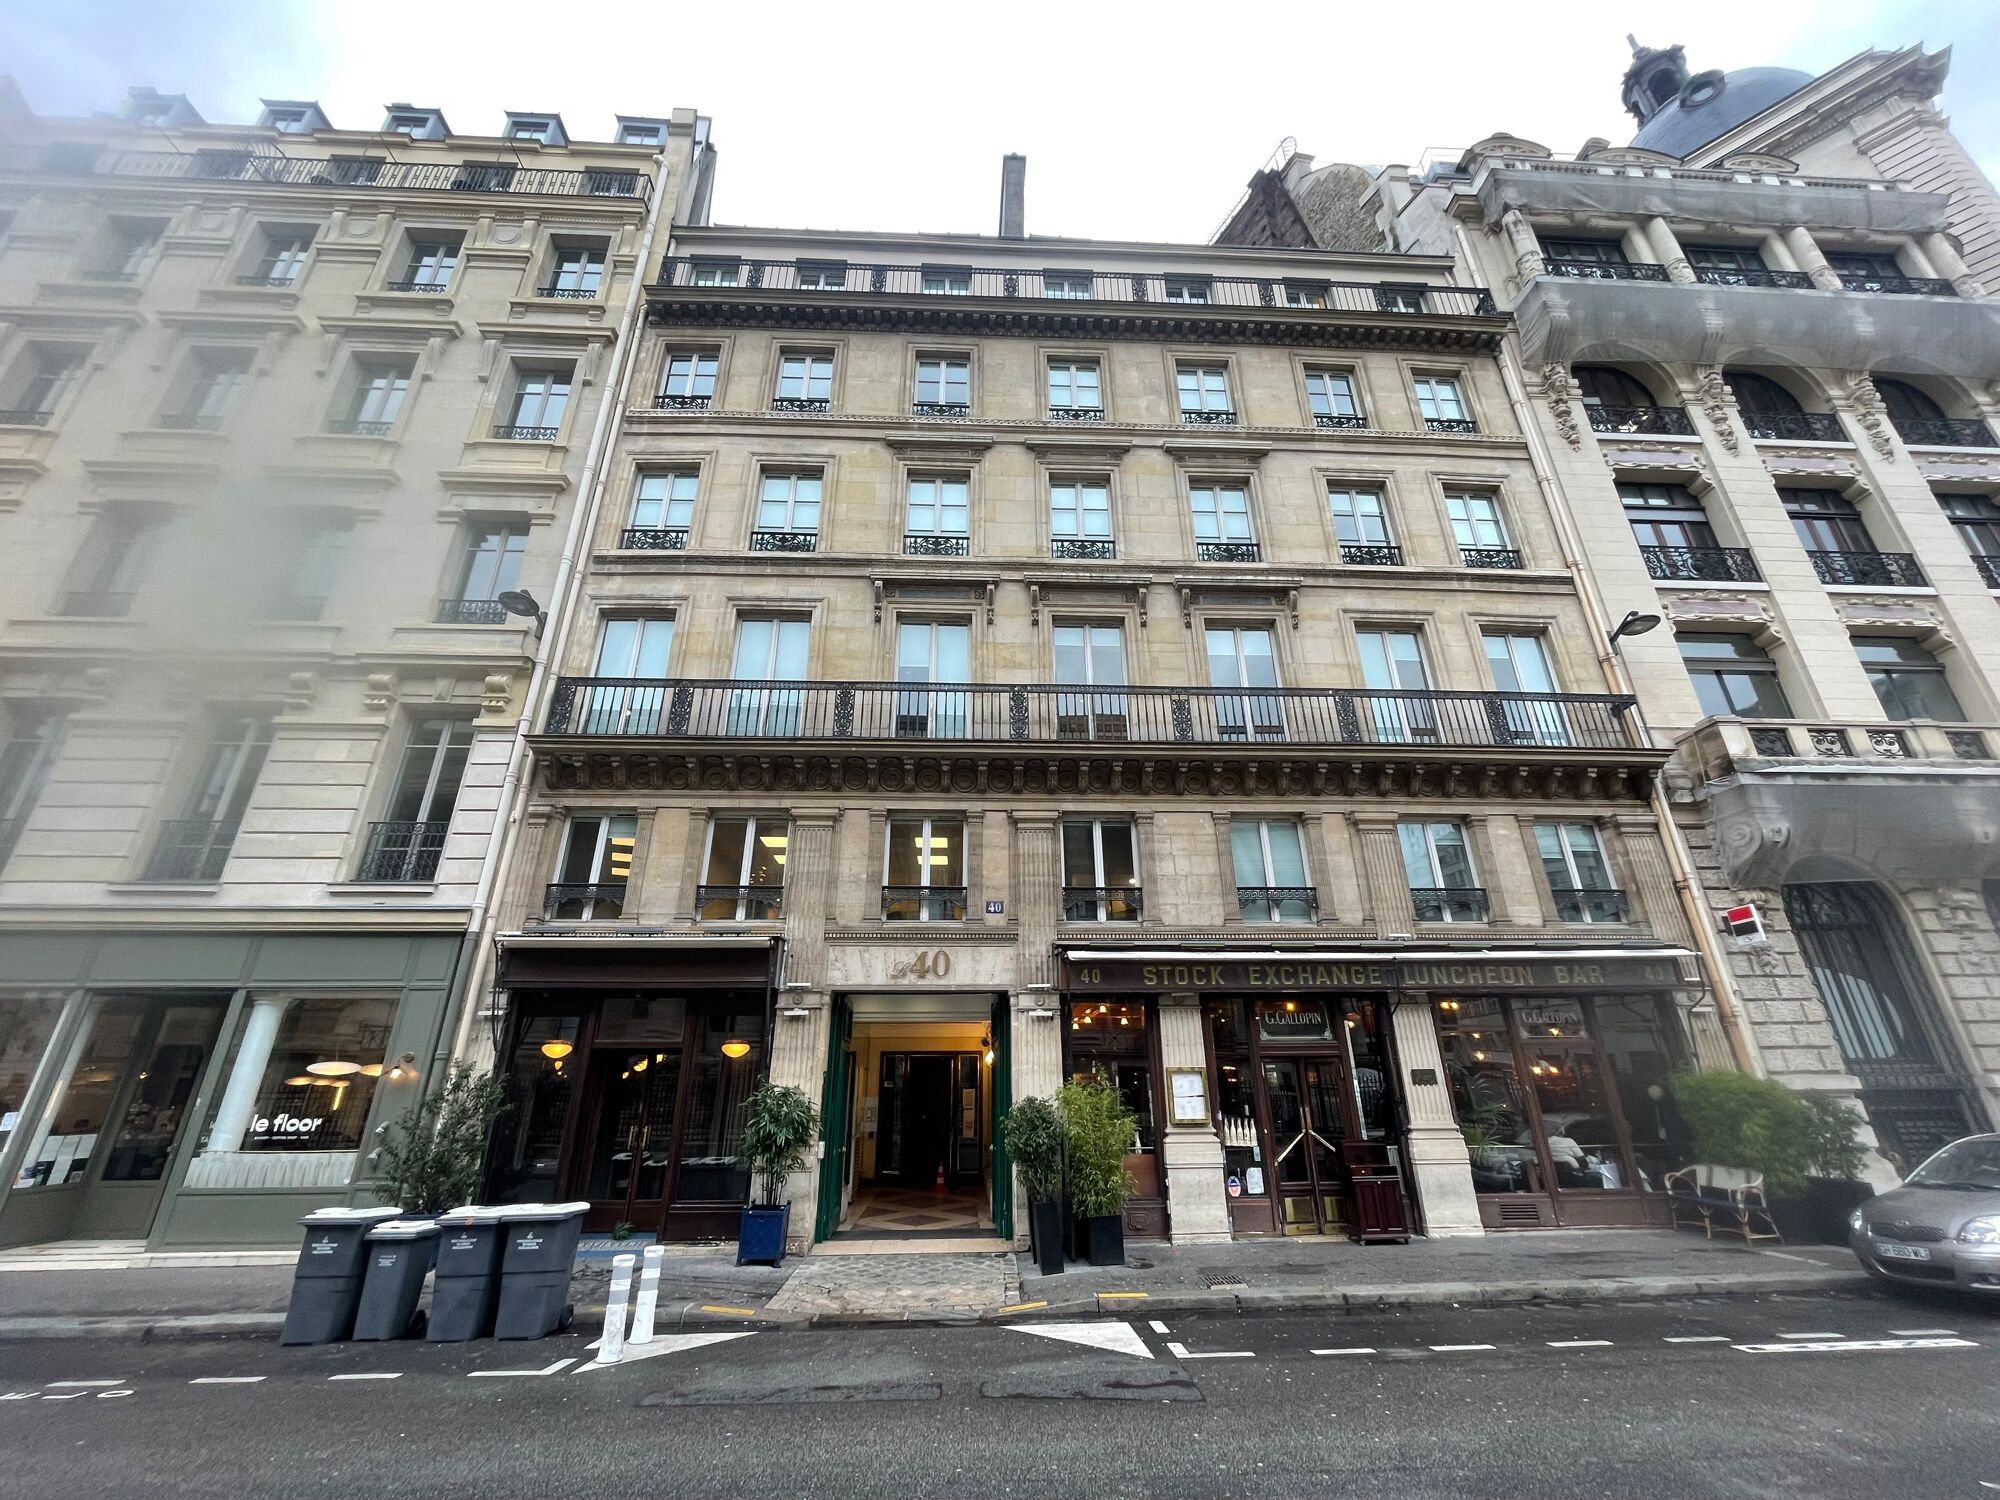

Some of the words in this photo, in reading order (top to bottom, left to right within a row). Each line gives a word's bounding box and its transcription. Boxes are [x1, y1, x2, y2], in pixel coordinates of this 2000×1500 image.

[988, 902, 1002, 913] 40
[911, 951, 951, 978] 40
[1080, 968, 1101, 984] 40
[1143, 966, 1226, 986] STOCK
[1249, 966, 1383, 986] EXCHANGE
[1403, 965, 1534, 986] LUNCHEON
[1555, 965, 1604, 985] BAR
[249, 1113, 270, 1133] le
[273, 1113, 323, 1133] floor
